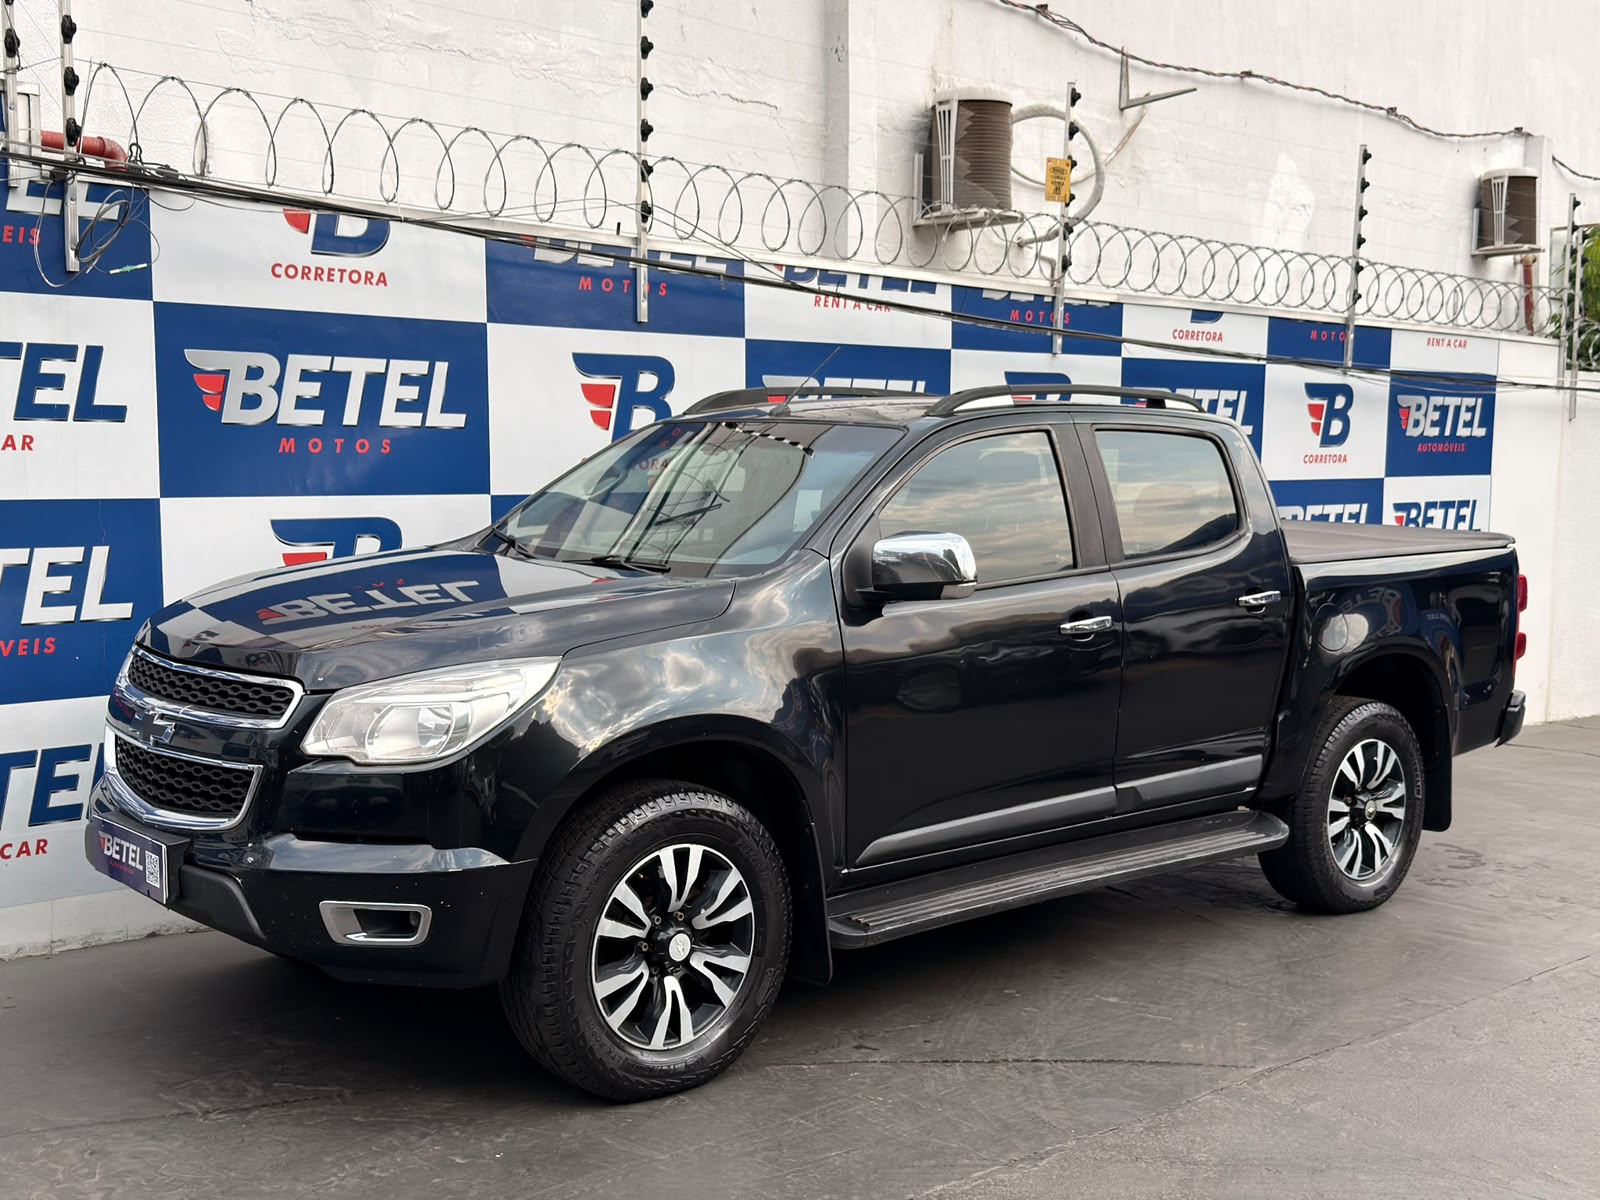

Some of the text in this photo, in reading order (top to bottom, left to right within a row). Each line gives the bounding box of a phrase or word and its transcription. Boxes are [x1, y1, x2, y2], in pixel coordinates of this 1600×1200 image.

[271, 262, 388, 287] CORRETORA
[578, 275, 668, 297] MOTS
[814, 294, 848, 309] RENT
[1172, 329, 1223, 343] CORRETORA
[1310, 330, 1347, 342] MOTO
[1426, 337, 1467, 349] RENT A CAR
[0, 340, 128, 423] EL
[184, 348, 467, 429] BETEL
[1397, 394, 1487, 438] BETEL
[278, 437, 392, 454] MOTOS
[1416, 441, 1466, 453] AUTOMÓVEIS
[1303, 454, 1348, 464] CORRETORA
[0, 838, 49, 860] CAR
[98, 830, 144, 871] BETEL
